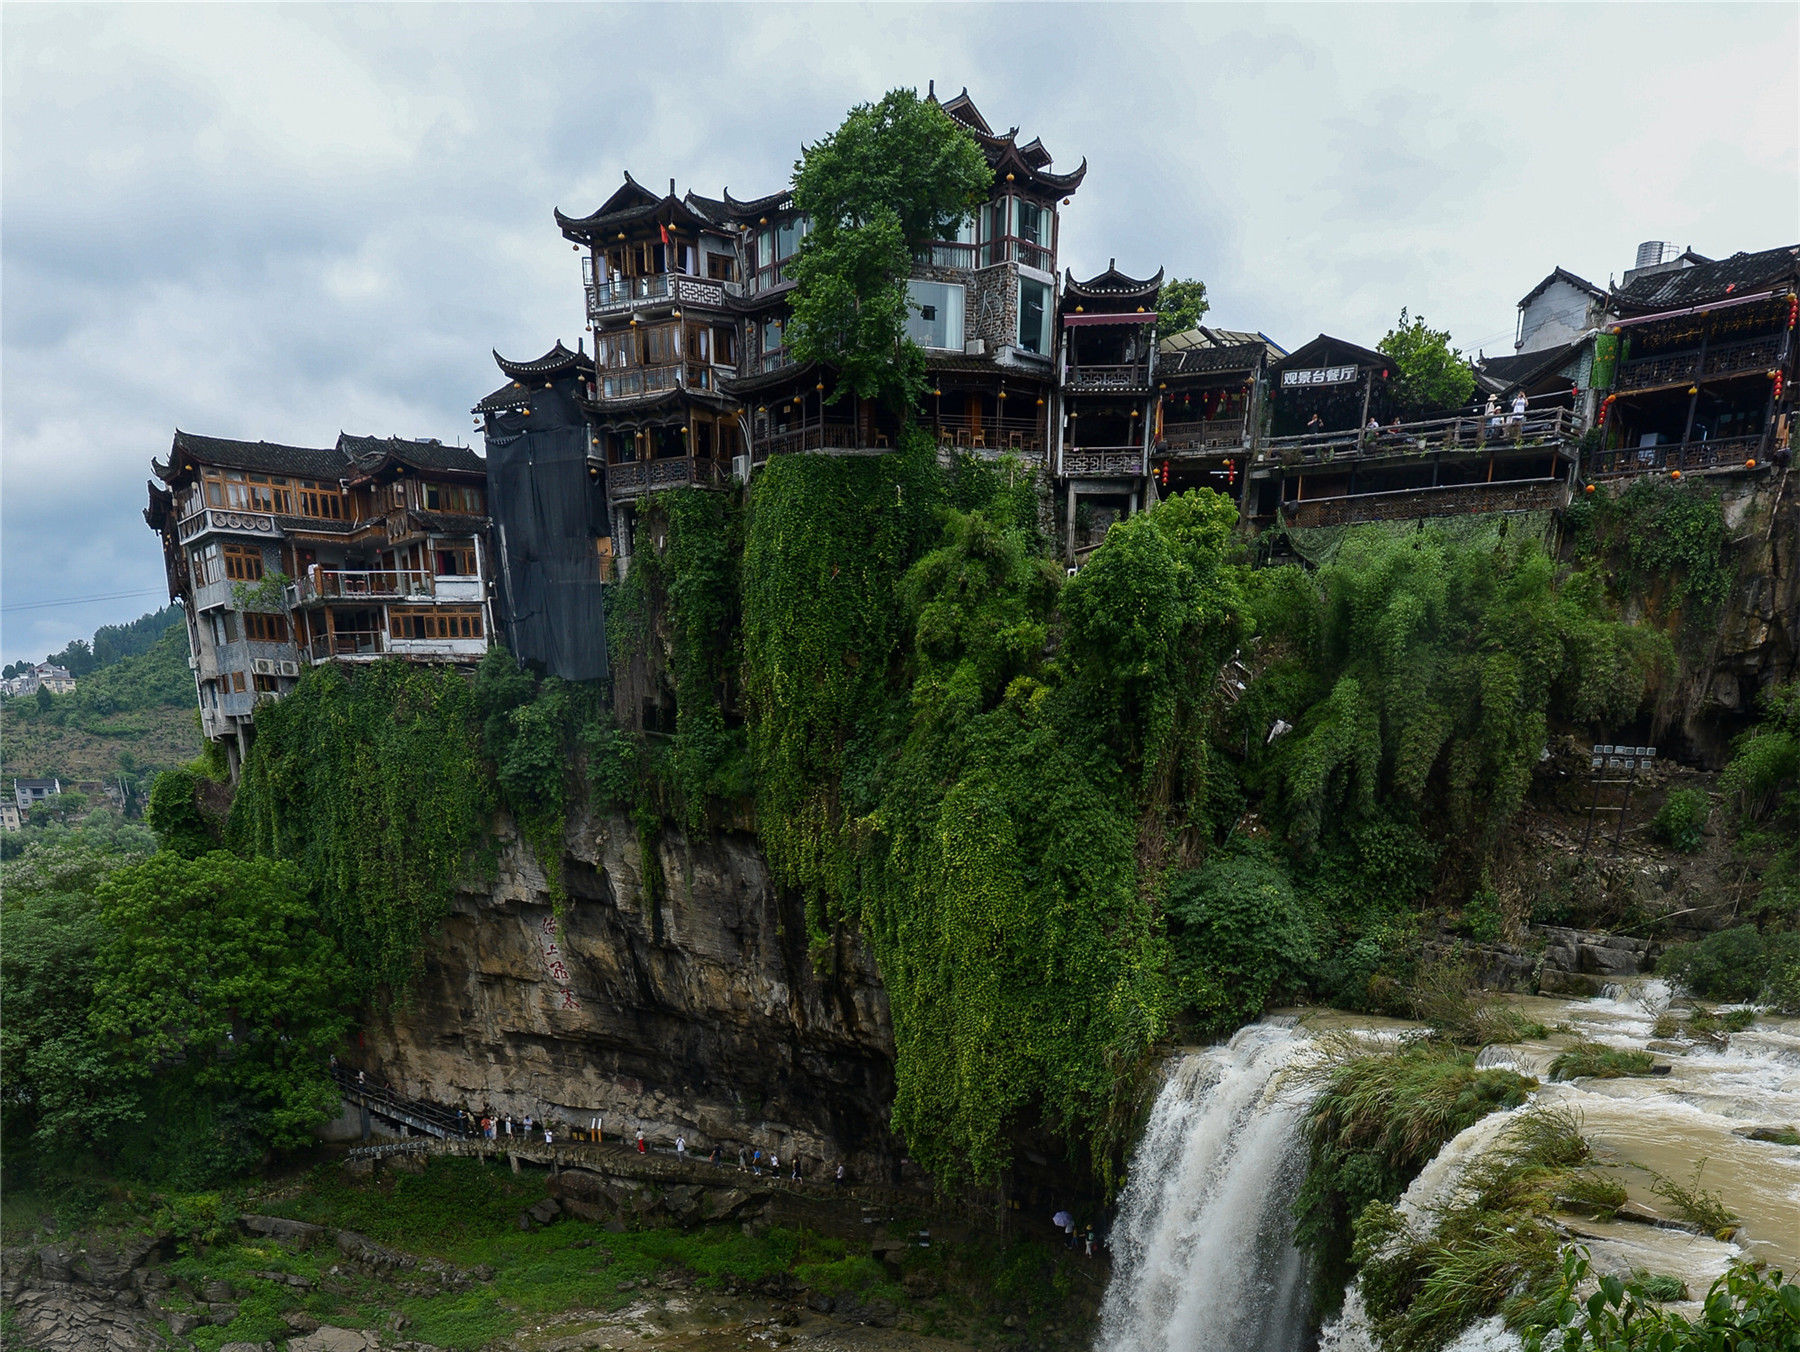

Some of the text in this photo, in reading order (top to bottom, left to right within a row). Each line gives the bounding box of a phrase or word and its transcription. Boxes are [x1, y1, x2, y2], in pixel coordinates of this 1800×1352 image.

[1283, 367, 1355, 385] 观景台餐厅
